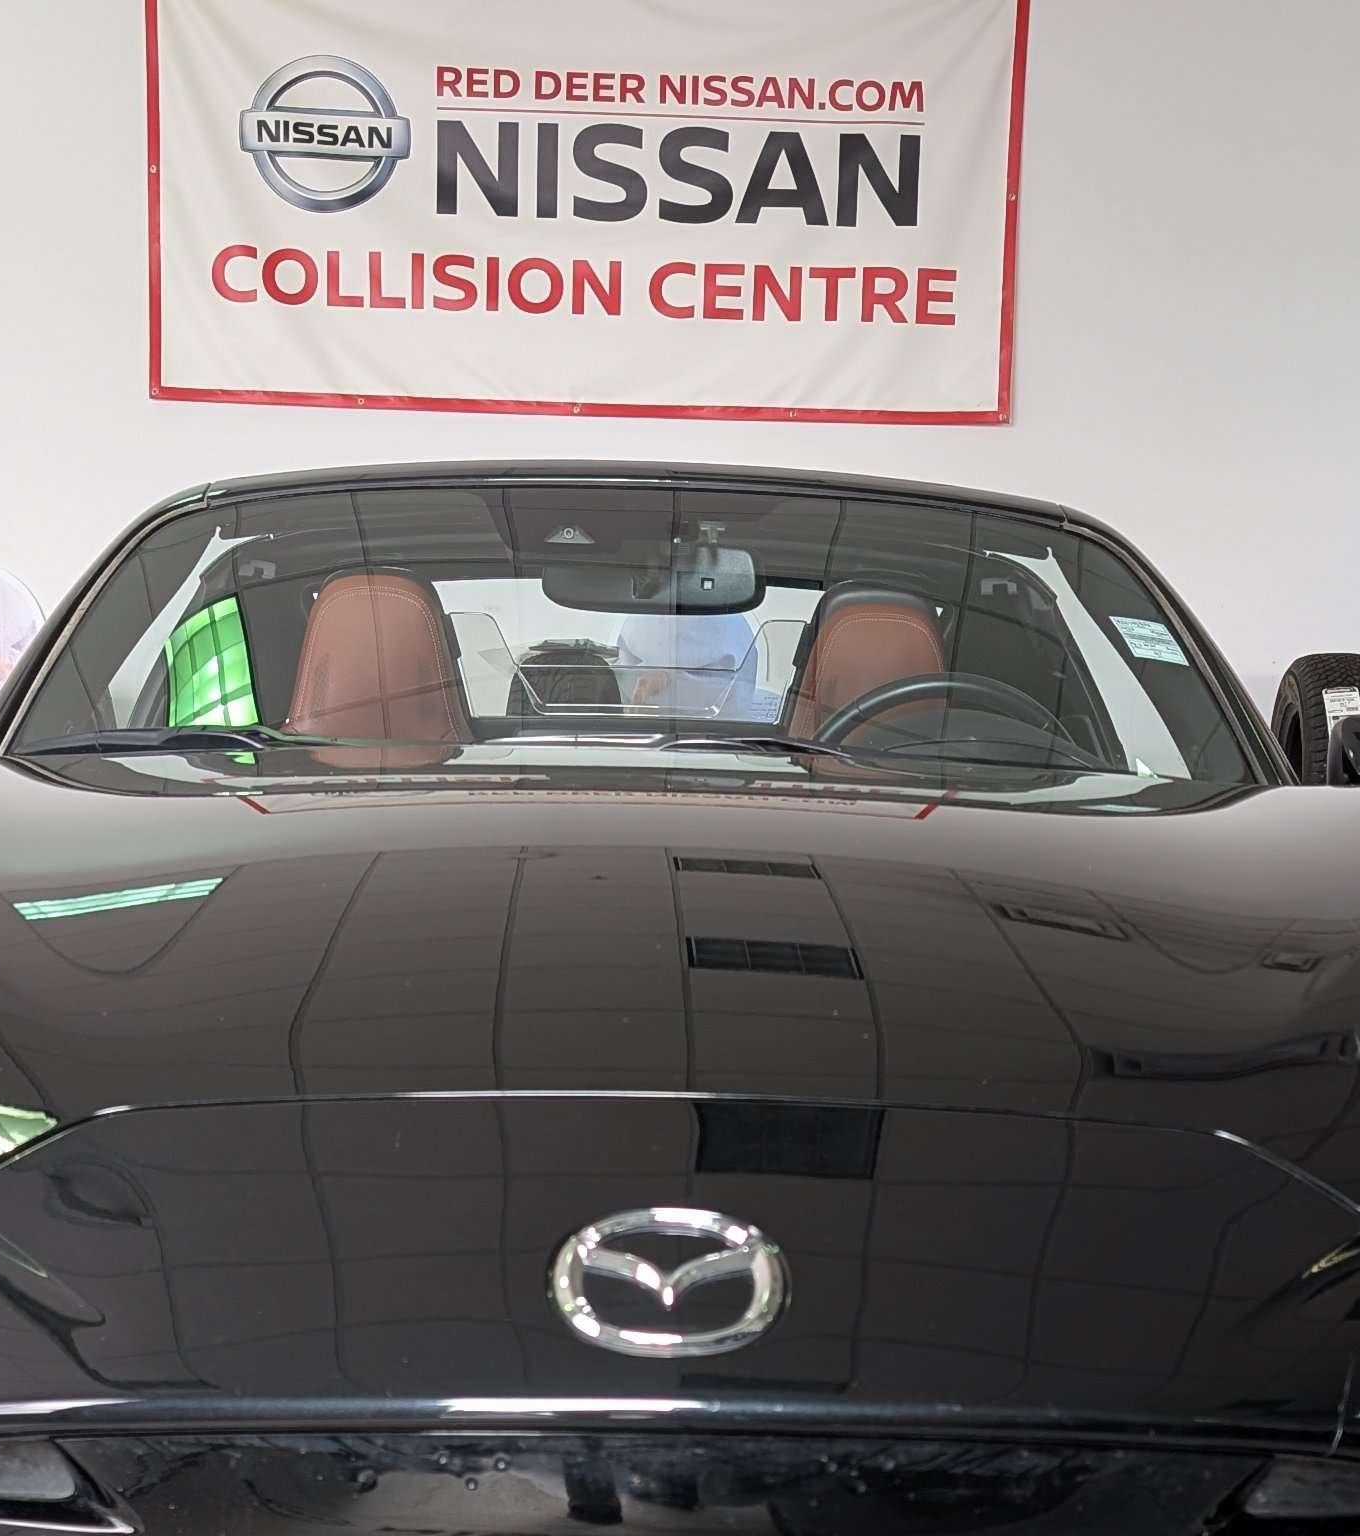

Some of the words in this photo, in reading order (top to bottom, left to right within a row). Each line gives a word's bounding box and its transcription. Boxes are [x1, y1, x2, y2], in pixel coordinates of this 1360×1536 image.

[435, 65, 520, 101] RED
[533, 69, 646, 105] DEER
[658, 74, 926, 114] NISSAN.COM
[257, 119, 393, 149] NISSAN
[435, 119, 921, 228] NISSAN
[211, 244, 623, 317] COLLISION
[648, 261, 957, 326] CENTRE
